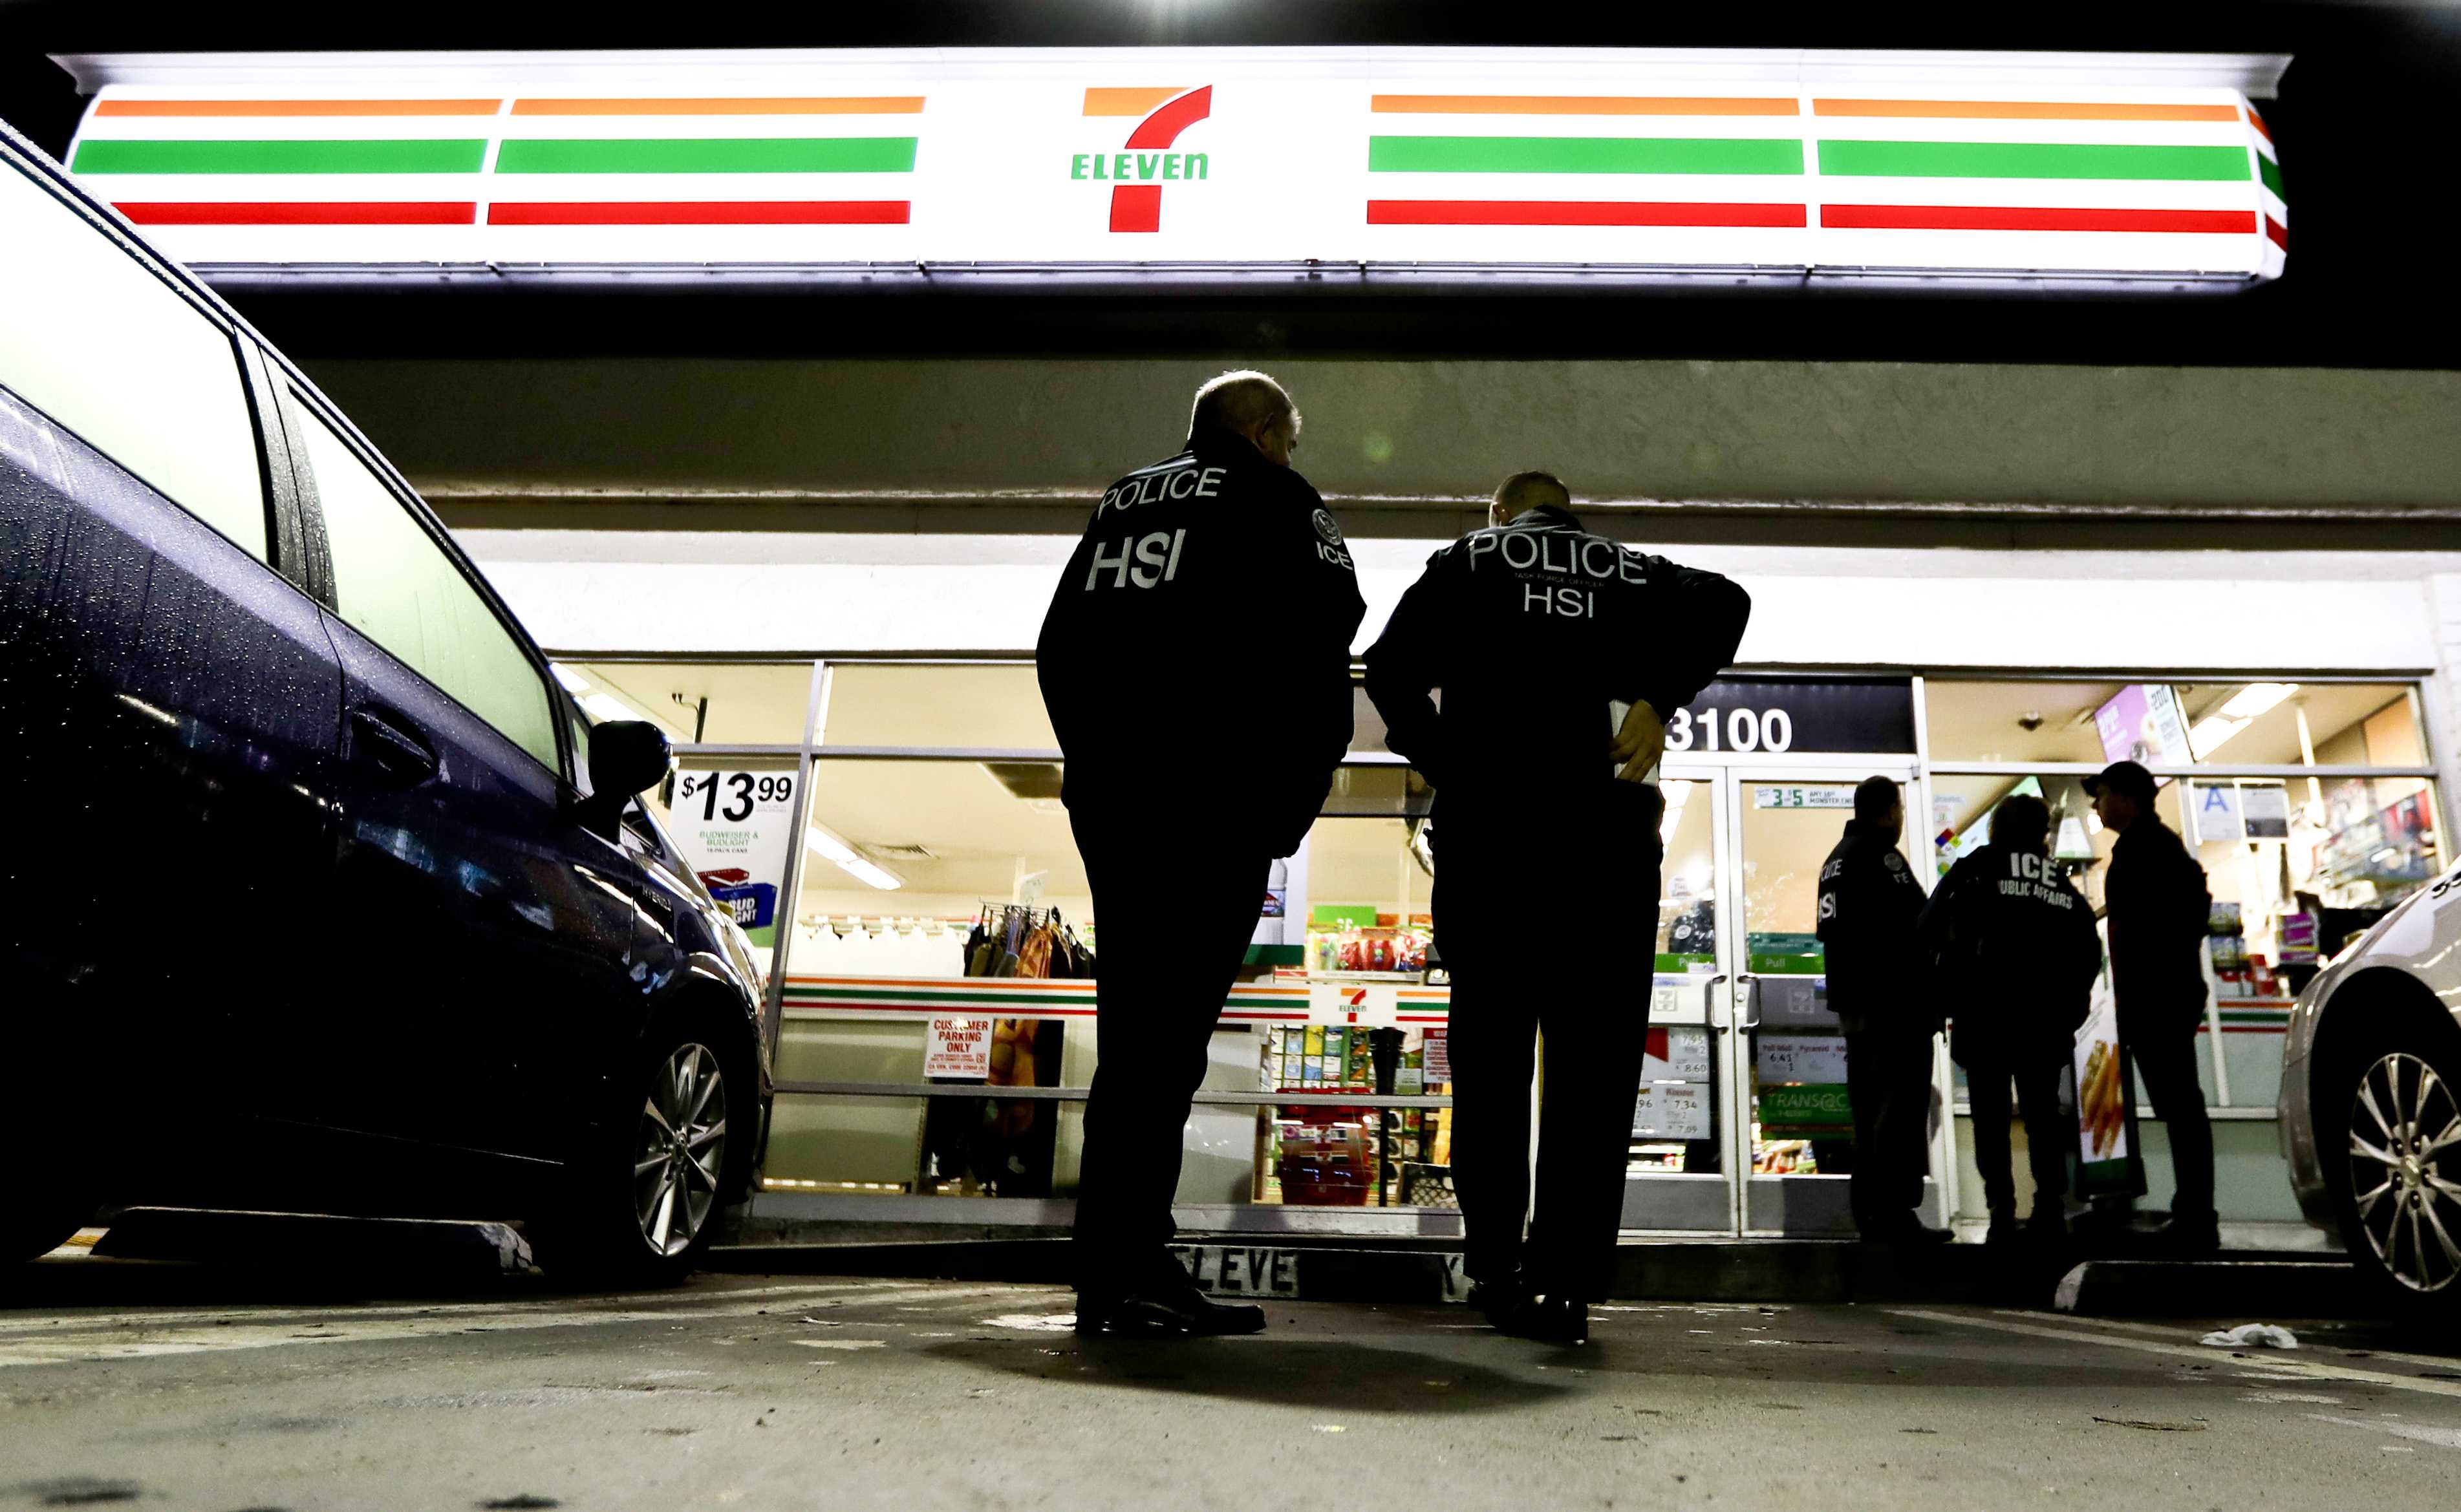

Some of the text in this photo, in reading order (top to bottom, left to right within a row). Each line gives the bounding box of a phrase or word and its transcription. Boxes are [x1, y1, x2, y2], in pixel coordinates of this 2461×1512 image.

[1082, 85, 1212, 232] 7
[1098, 467, 1227, 520] POLICE
[1085, 529, 1186, 591] HSI
[1316, 540, 1353, 570] ICE
[1469, 532, 1647, 584] POLICE
[1524, 583, 1593, 619] HSI
[1664, 707, 1792, 752] 3100
[1772, 789, 1783, 807] 3
[2204, 786, 2229, 812] A
[1820, 858, 1843, 882] OLICE
[2010, 852, 2059, 888] ICE
[1818, 891, 1836, 923] SI
[1998, 879, 2073, 910] UBLIC AFFAIRS
[735, 909, 757, 924] GHT
[1765, 958, 1786, 968] Pull
[1340, 988, 1366, 1022] 7
[934, 1019, 989, 1031] CUSMER
[938, 1031, 982, 1042] PARKING
[947, 1042, 971, 1053] ONLY
